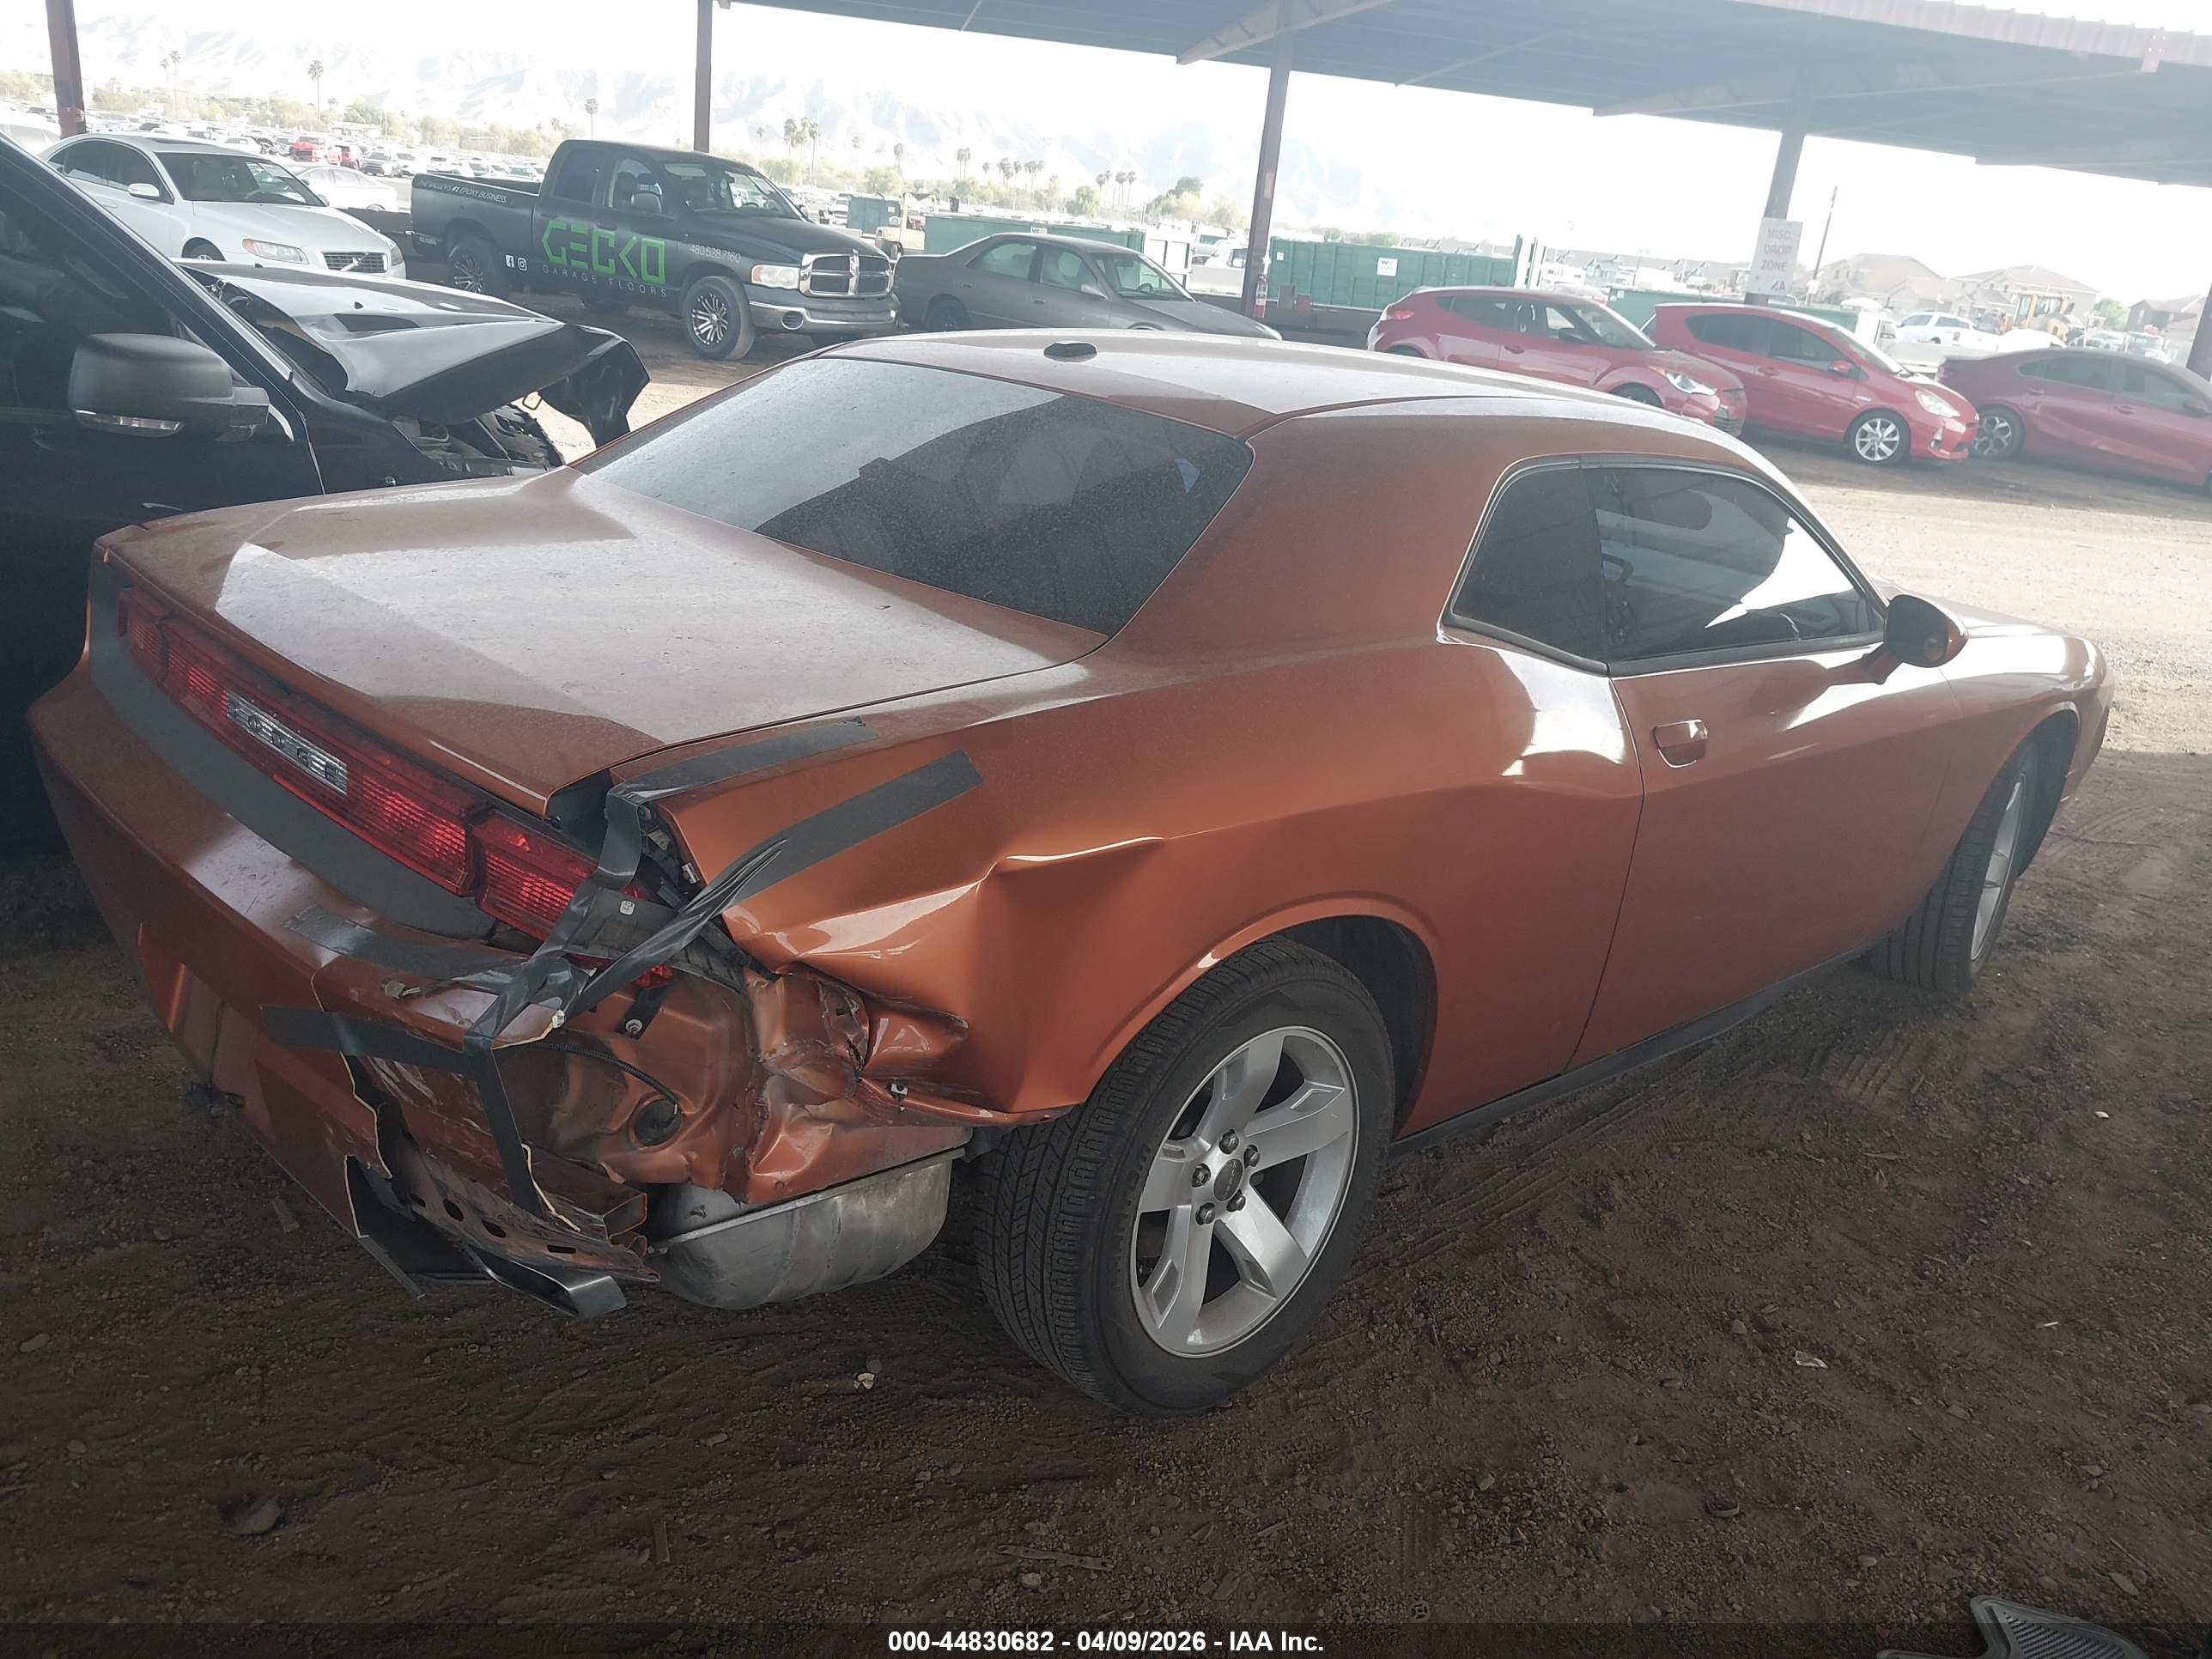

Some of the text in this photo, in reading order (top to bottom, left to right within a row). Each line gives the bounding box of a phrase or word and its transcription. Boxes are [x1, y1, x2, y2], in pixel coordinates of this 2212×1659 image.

[478, 191, 507, 204] BUSINESS
[542, 220, 665, 285] GECKO
[1761, 260, 1786, 271] ZONE
[542, 264, 667, 298] GARAGE FLOORS
[227, 699, 341, 783] DODGE
